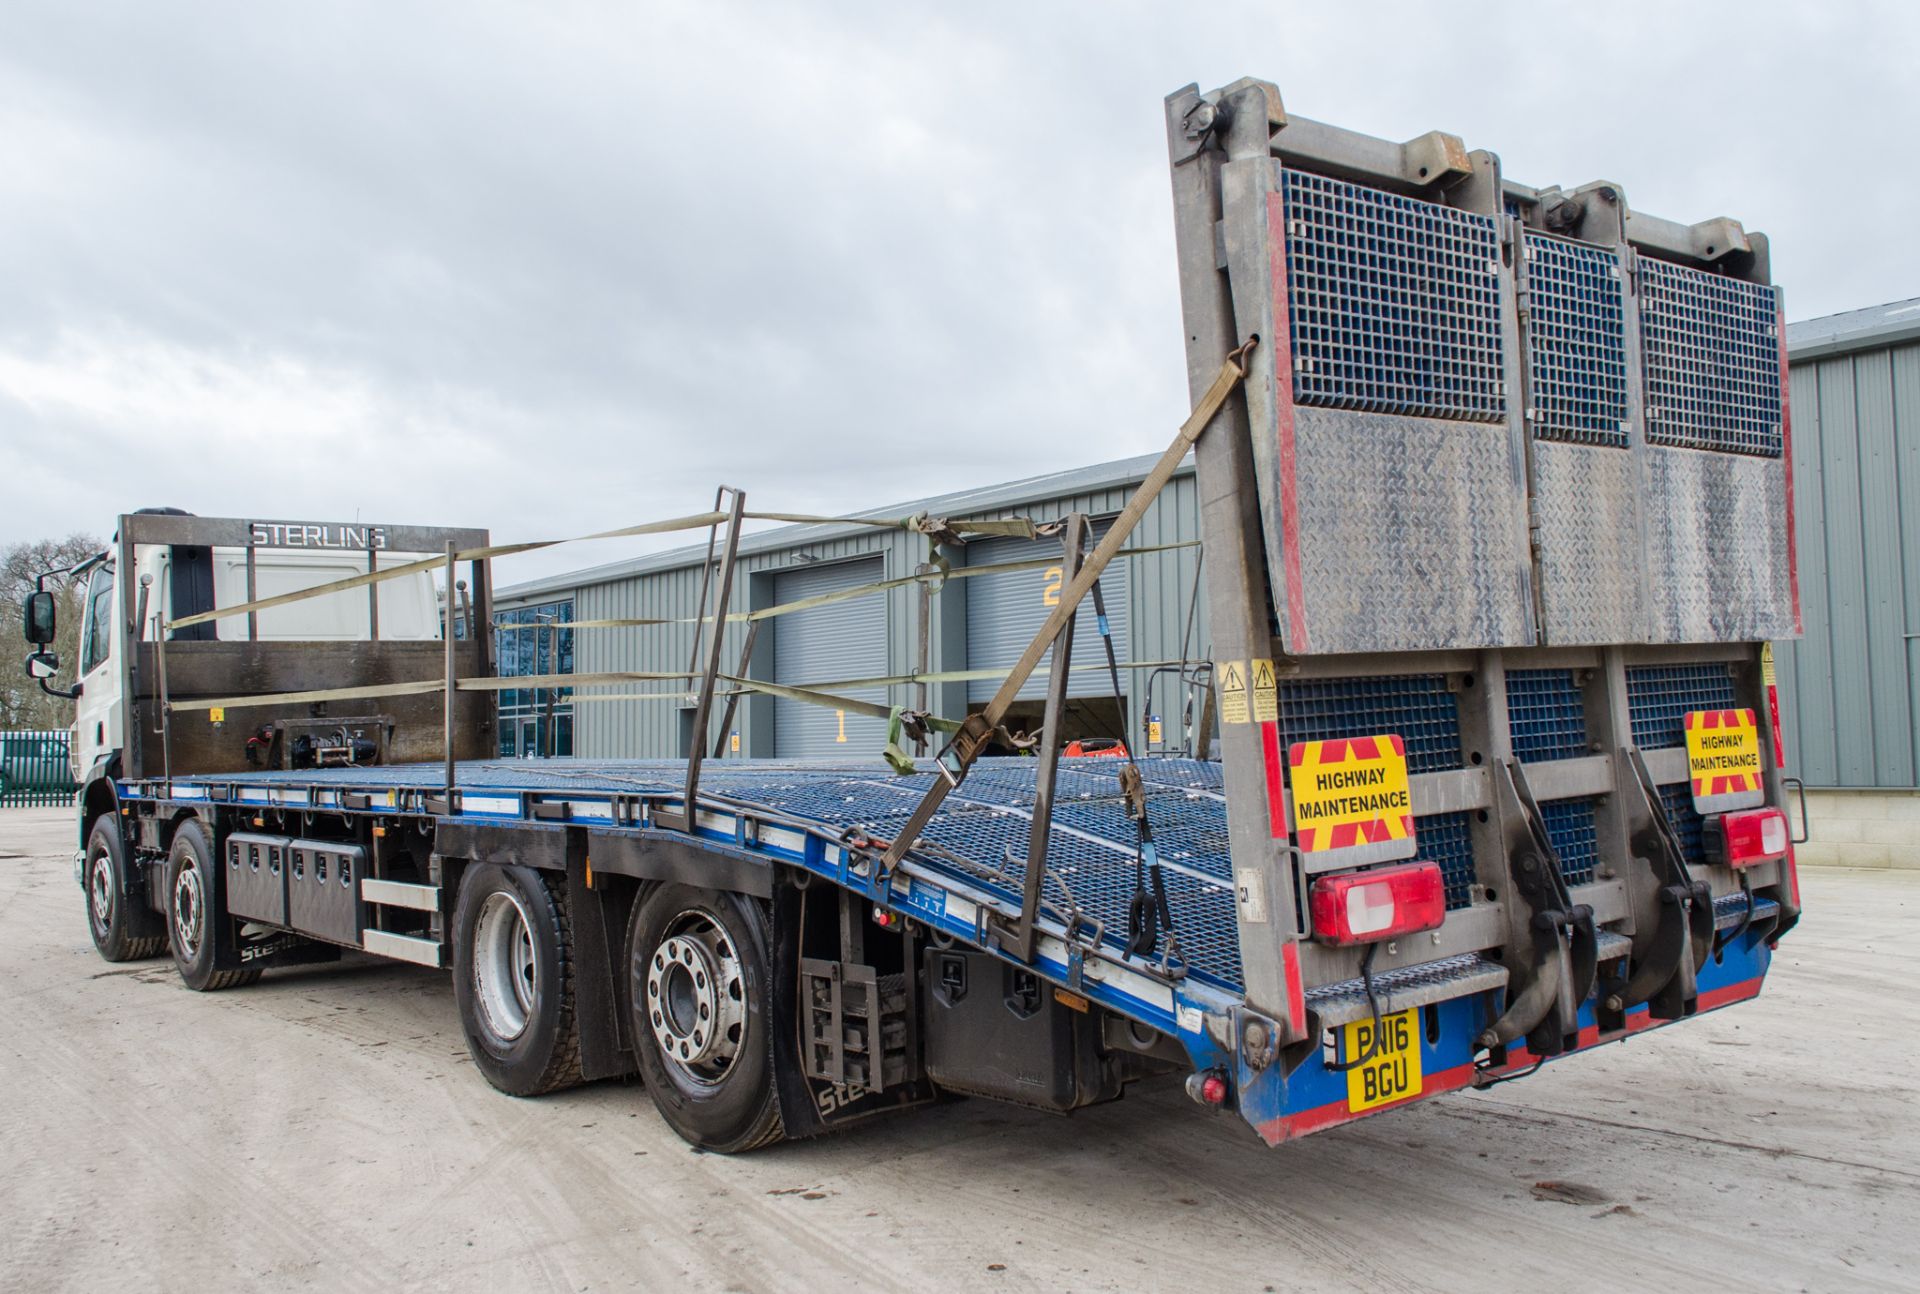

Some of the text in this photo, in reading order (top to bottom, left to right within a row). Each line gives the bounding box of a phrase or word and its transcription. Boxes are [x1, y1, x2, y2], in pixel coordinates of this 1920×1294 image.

[250, 523, 386, 548] STERLING
[1043, 566, 1063, 607] 2
[836, 709, 847, 743] 1
[1701, 735, 1743, 749] HIGHWAY
[1691, 754, 1757, 771] MAINTENANCE
[1316, 768, 1385, 791] HIGHWAY
[1299, 791, 1408, 820] MAINTENANCE
[1357, 1017, 1408, 1060] PN16
[1363, 1057, 1407, 1103] BGU
